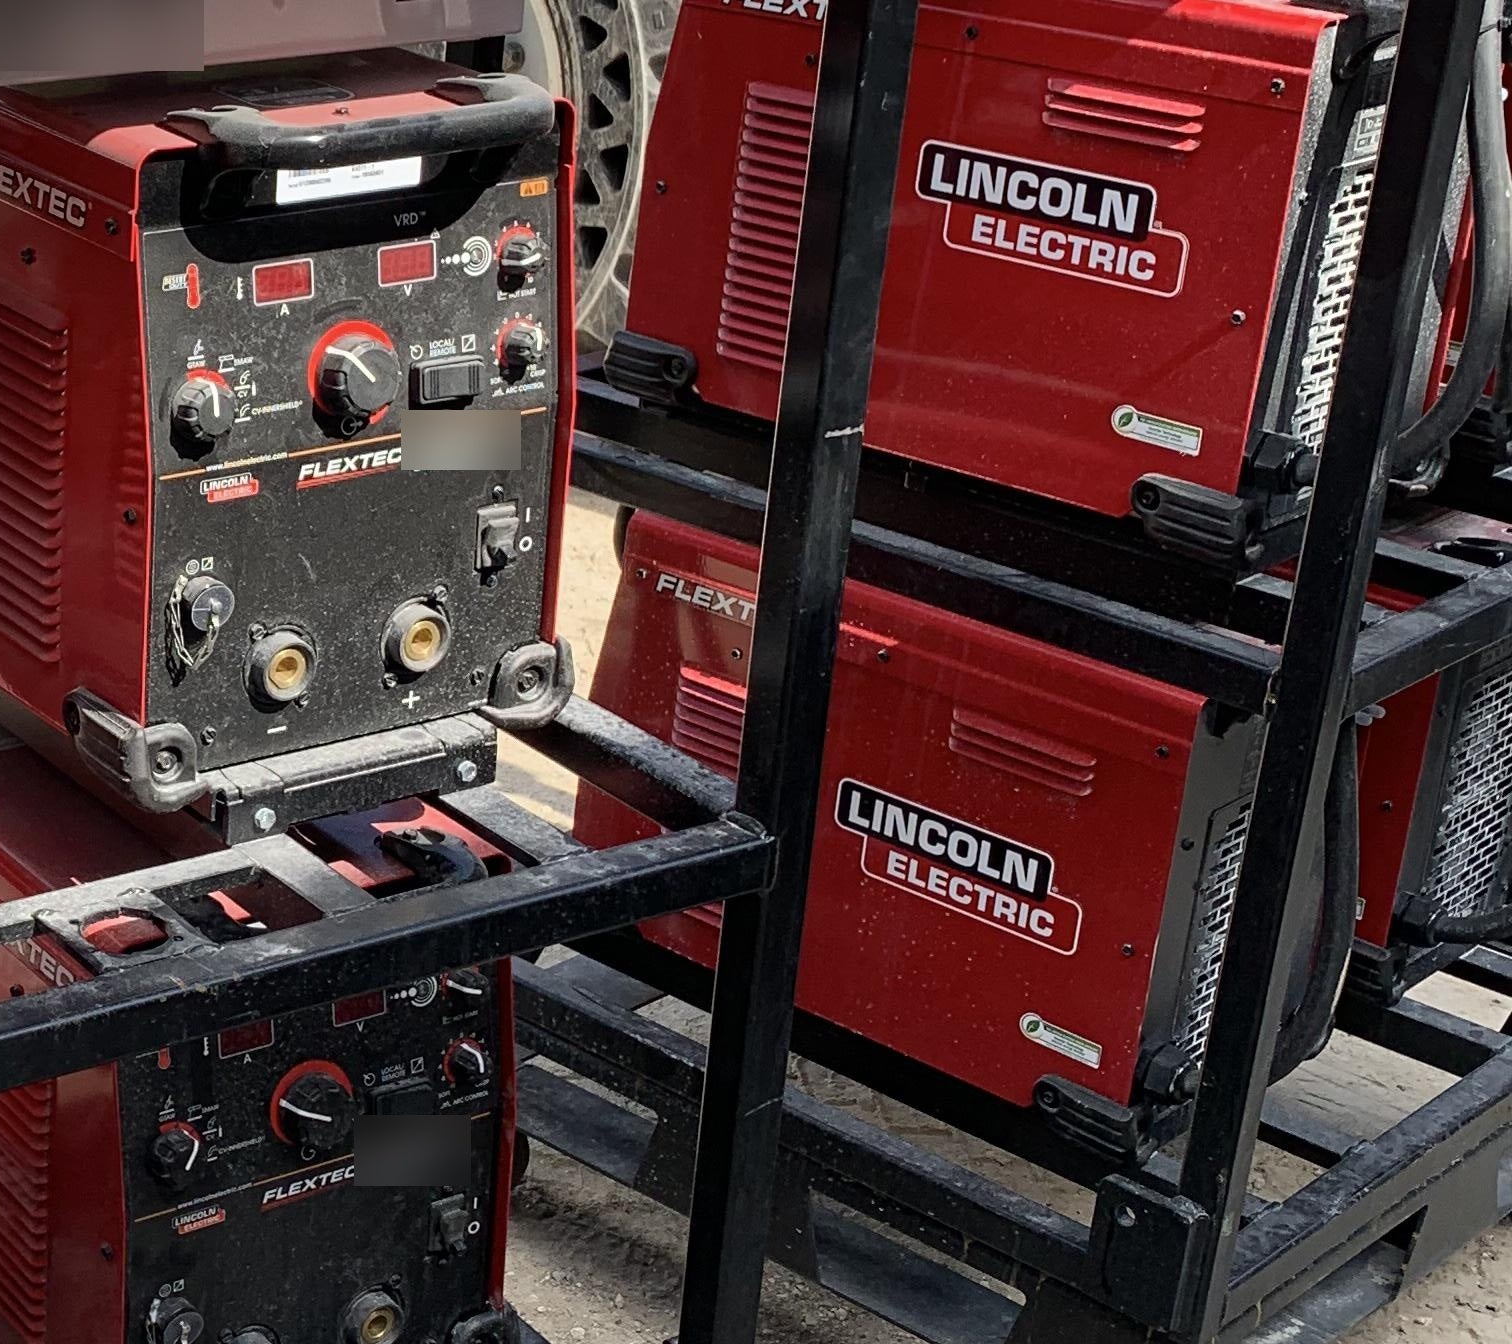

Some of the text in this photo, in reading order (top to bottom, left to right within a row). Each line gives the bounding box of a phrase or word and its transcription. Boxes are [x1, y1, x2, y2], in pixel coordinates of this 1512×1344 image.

[930, 153, 1139, 234] LINCOLN
[971, 213, 1157, 282] ELECTRIC
[403, 284, 413, 296] V
[279, 303, 290, 316] A
[429, 338, 455, 349] LOCAL/
[429, 345, 457, 356] REMOTE
[506, 381, 545, 395] ARC CONTROL
[205, 451, 288, 472] www.lincolnelectric.com
[298, 447, 401, 481] FLEXTEC
[202, 475, 249, 493] LINCOLN
[213, 485, 254, 499] ELECTRIC
[656, 573, 756, 621] FLEXT
[848, 790, 1039, 893] LINCOLN
[887, 850, 1055, 938] ELECTRIC
[356, 1021, 364, 1032] V
[242, 1054, 252, 1064] A
[453, 1091, 489, 1105] ARC CONTROL
[262, 1165, 354, 1205] FLEXTEC
[177, 1181, 253, 1209] www.lincolnelectric.com
[174, 1206, 217, 1226] LINCOLN
[183, 1215, 221, 1232] ELECTRIC
